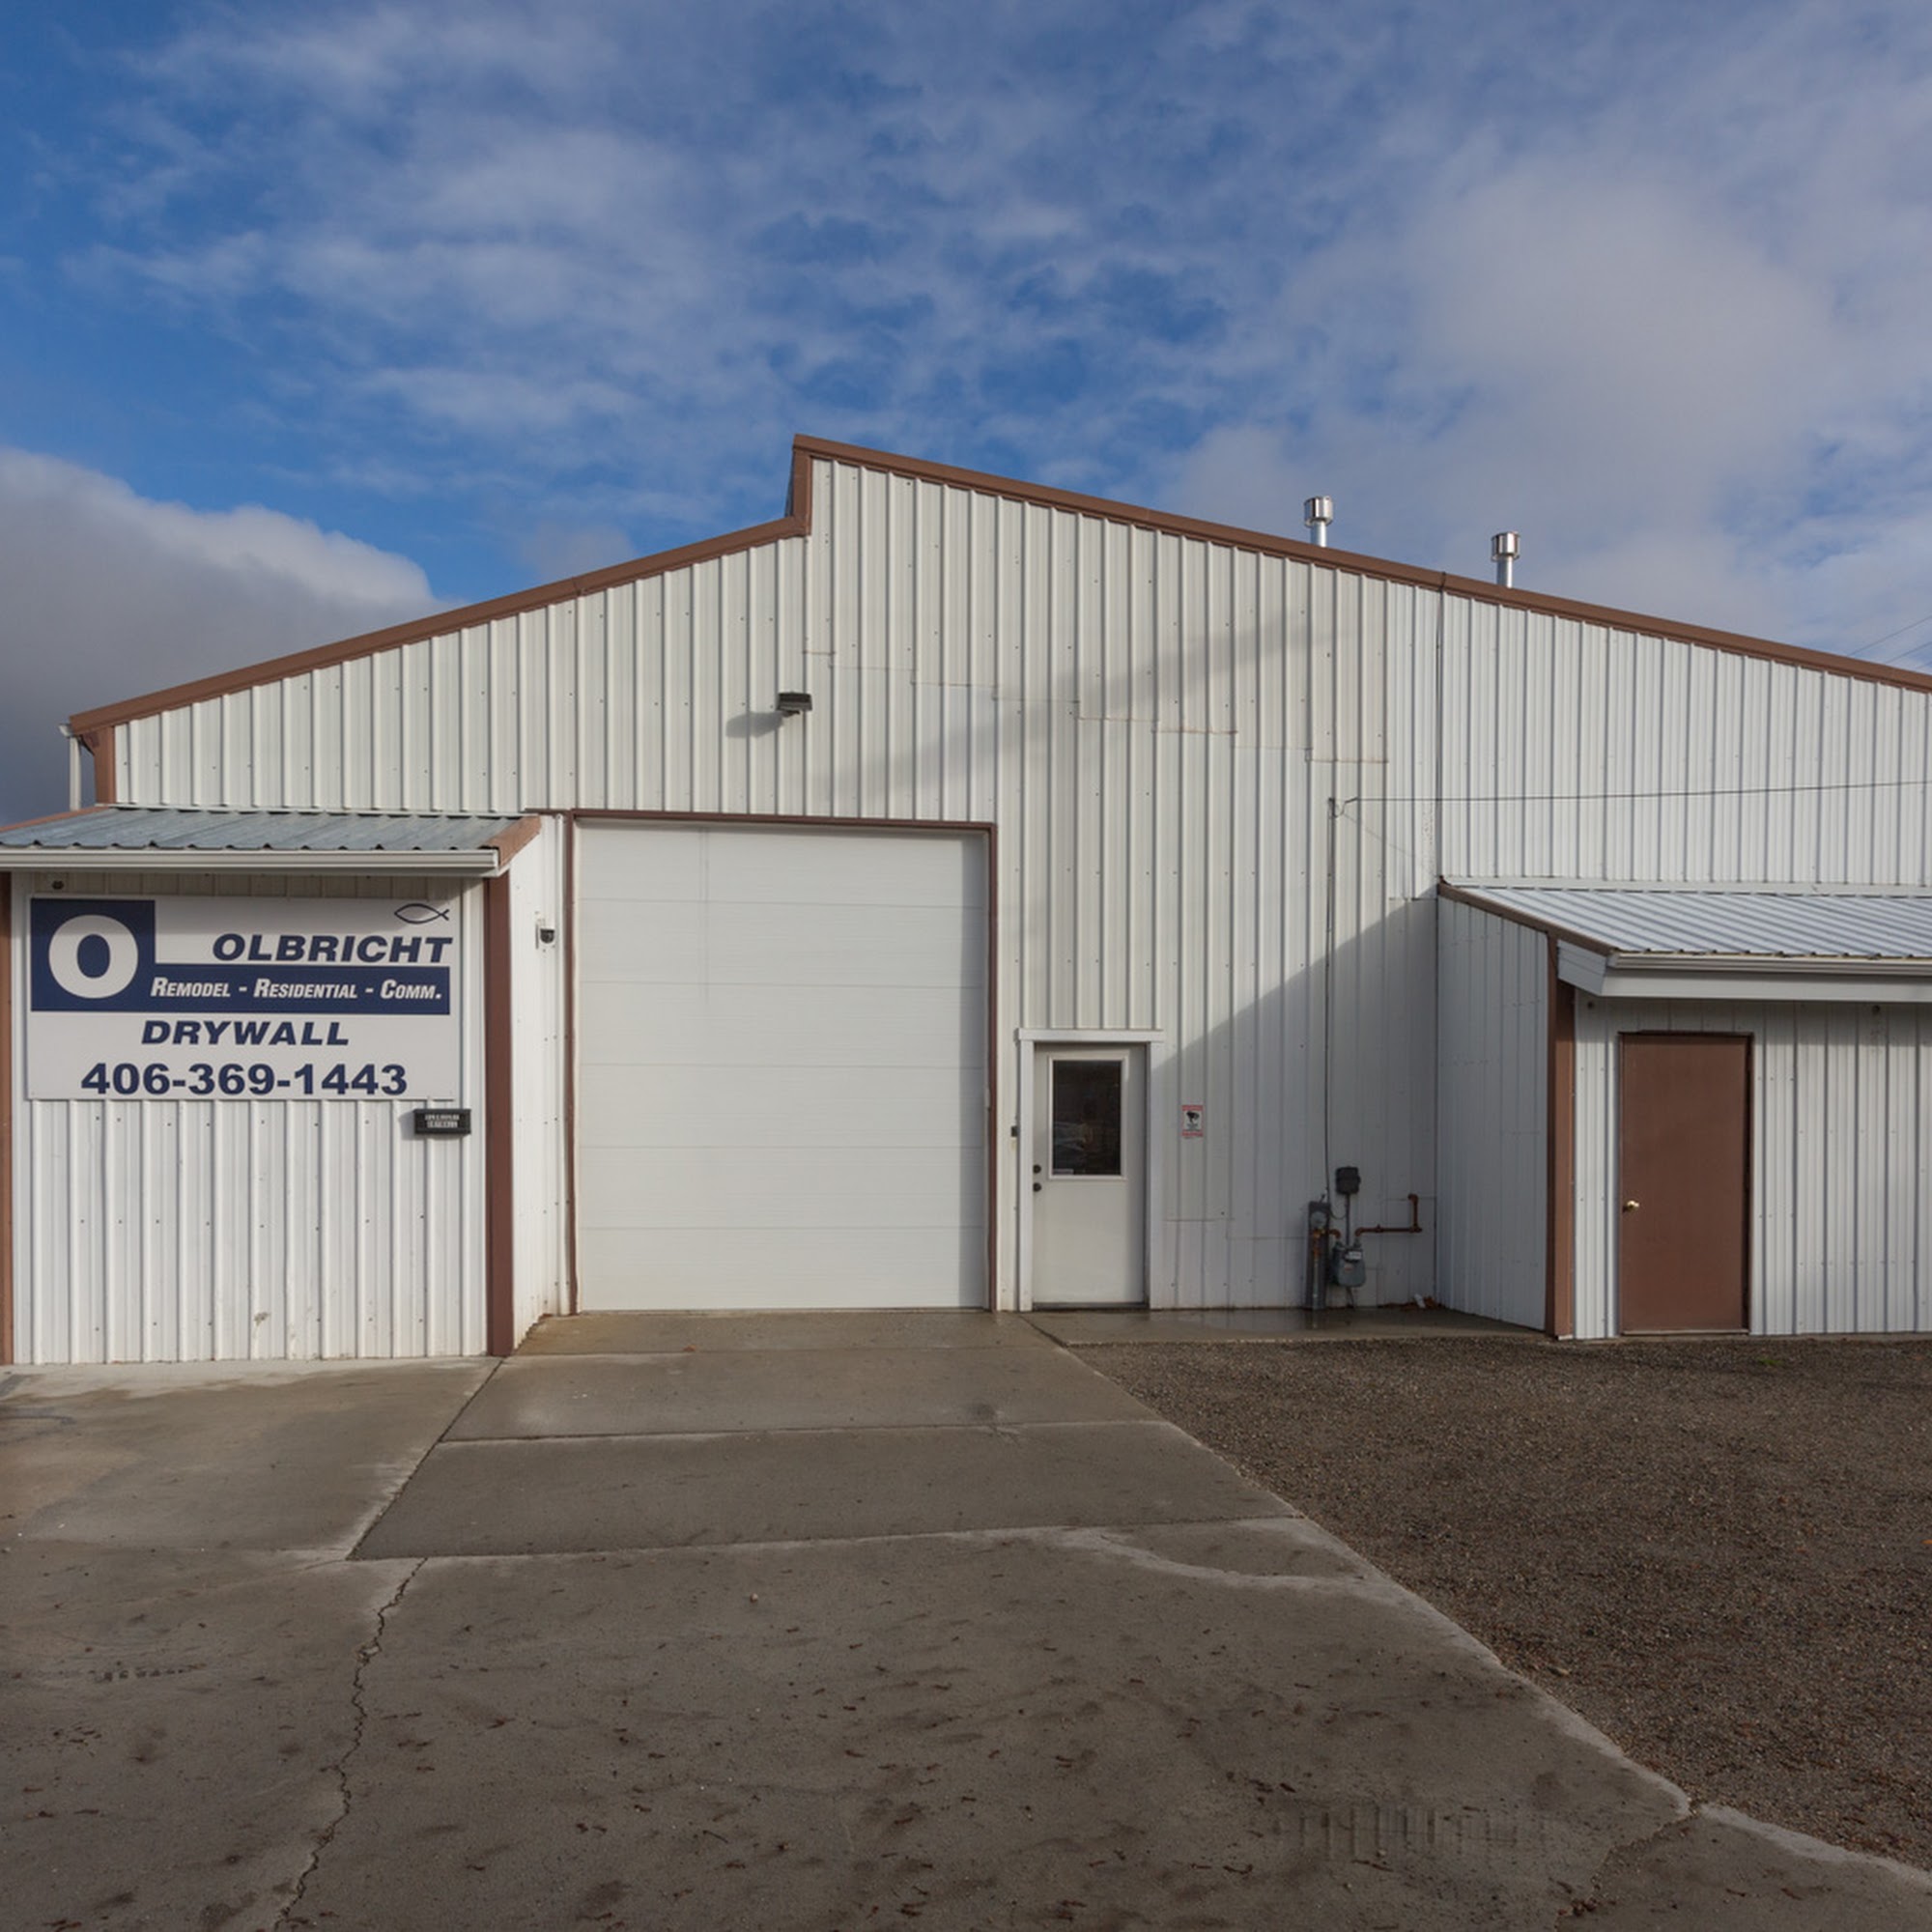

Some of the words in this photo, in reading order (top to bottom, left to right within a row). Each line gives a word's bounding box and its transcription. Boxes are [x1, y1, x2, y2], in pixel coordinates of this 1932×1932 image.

[48, 914, 139, 999] O
[212, 933, 453, 964] OLBRICHT
[141, 1020, 350, 1046] DRYWALL
[81, 1063, 408, 1095] 406-369-1443
